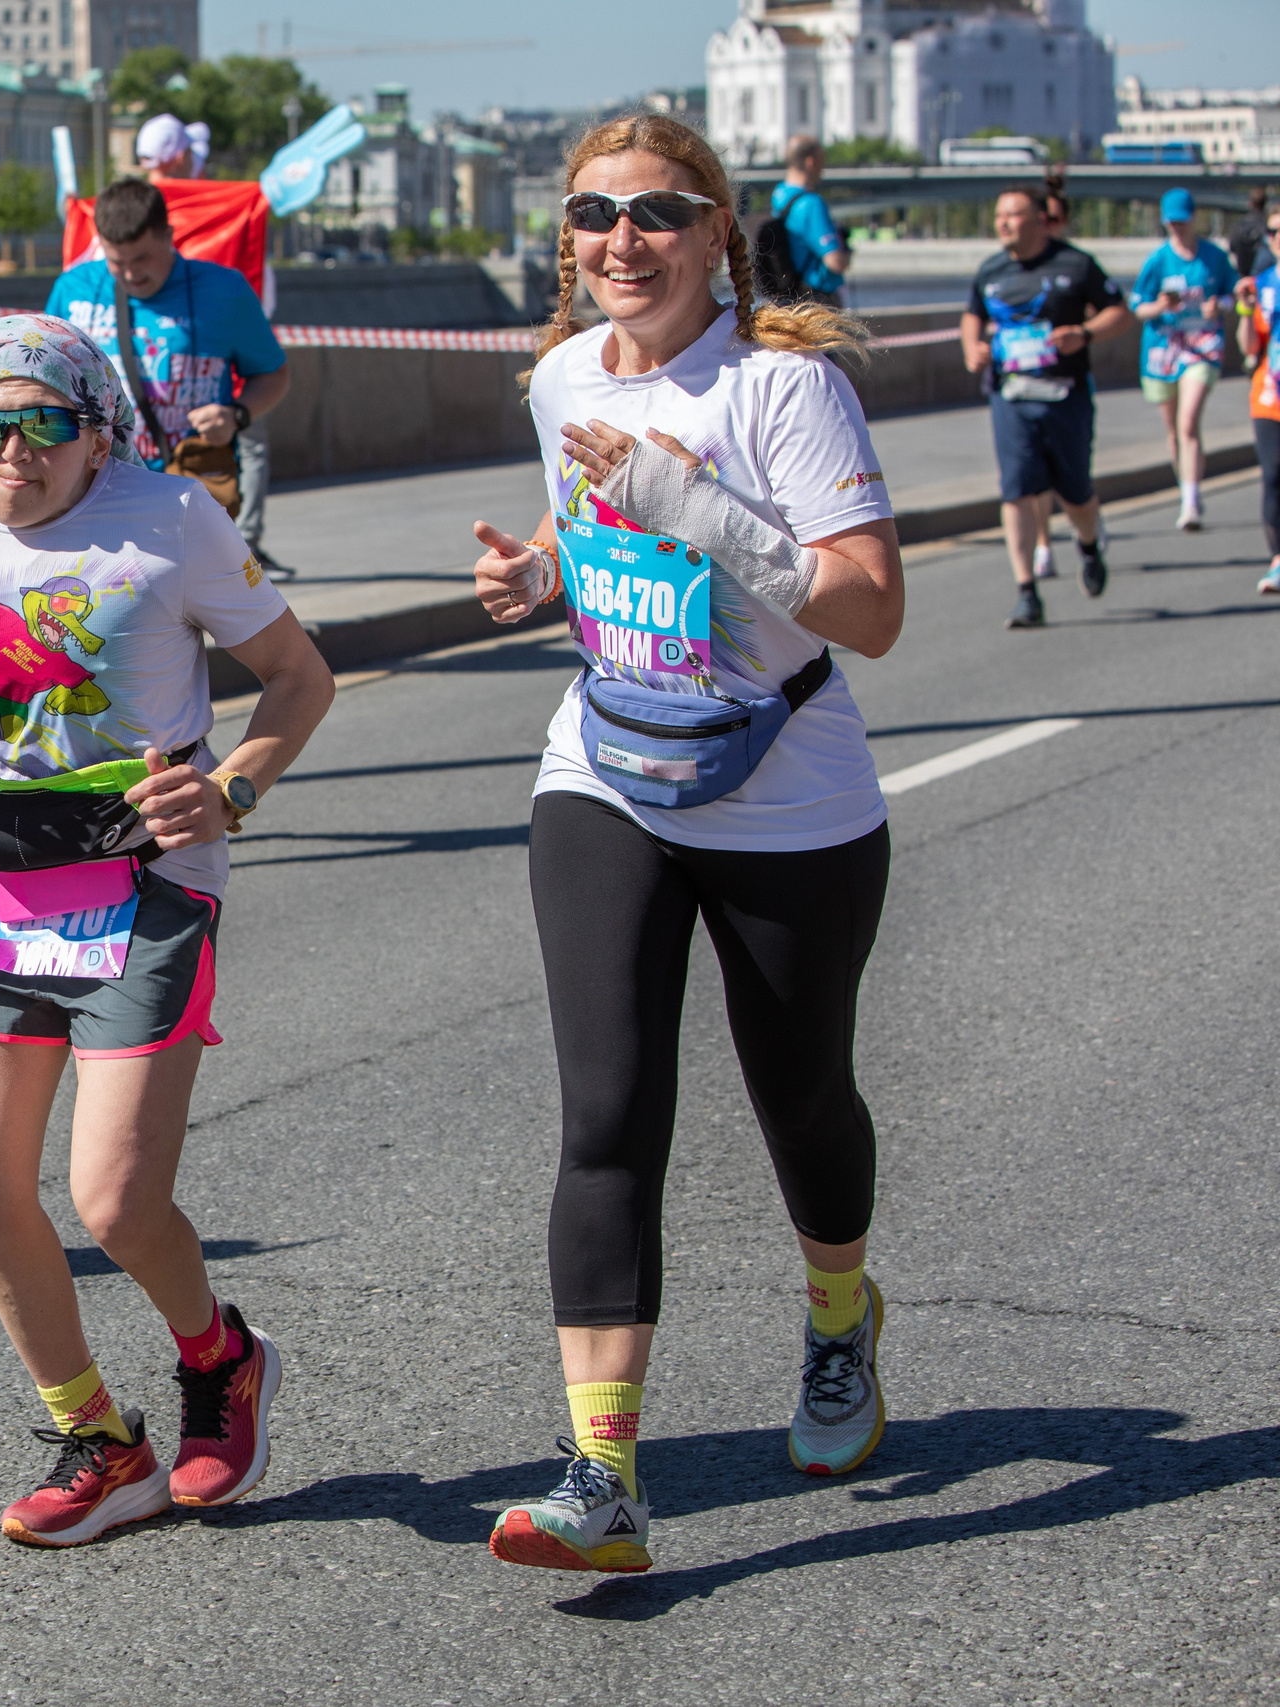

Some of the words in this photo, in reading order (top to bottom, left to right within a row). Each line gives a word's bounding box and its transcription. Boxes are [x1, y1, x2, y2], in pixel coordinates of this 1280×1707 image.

[573, 523, 593, 538] ПСБ
[580, 563, 676, 629] 36470
[14, 638, 47, 666] БОЛЬШЕ
[597, 621, 653, 671] 10KM
[666, 643, 680, 660] D
[0, 646, 35, 674] МОЖЕШЬ
[15, 647, 31, 663] ЧЕМ
[598, 754, 623, 768] DENIM
[599, 748, 628, 763] HILFIGER
[12, 940, 80, 977] 10KM
[87, 950, 101, 966] D
